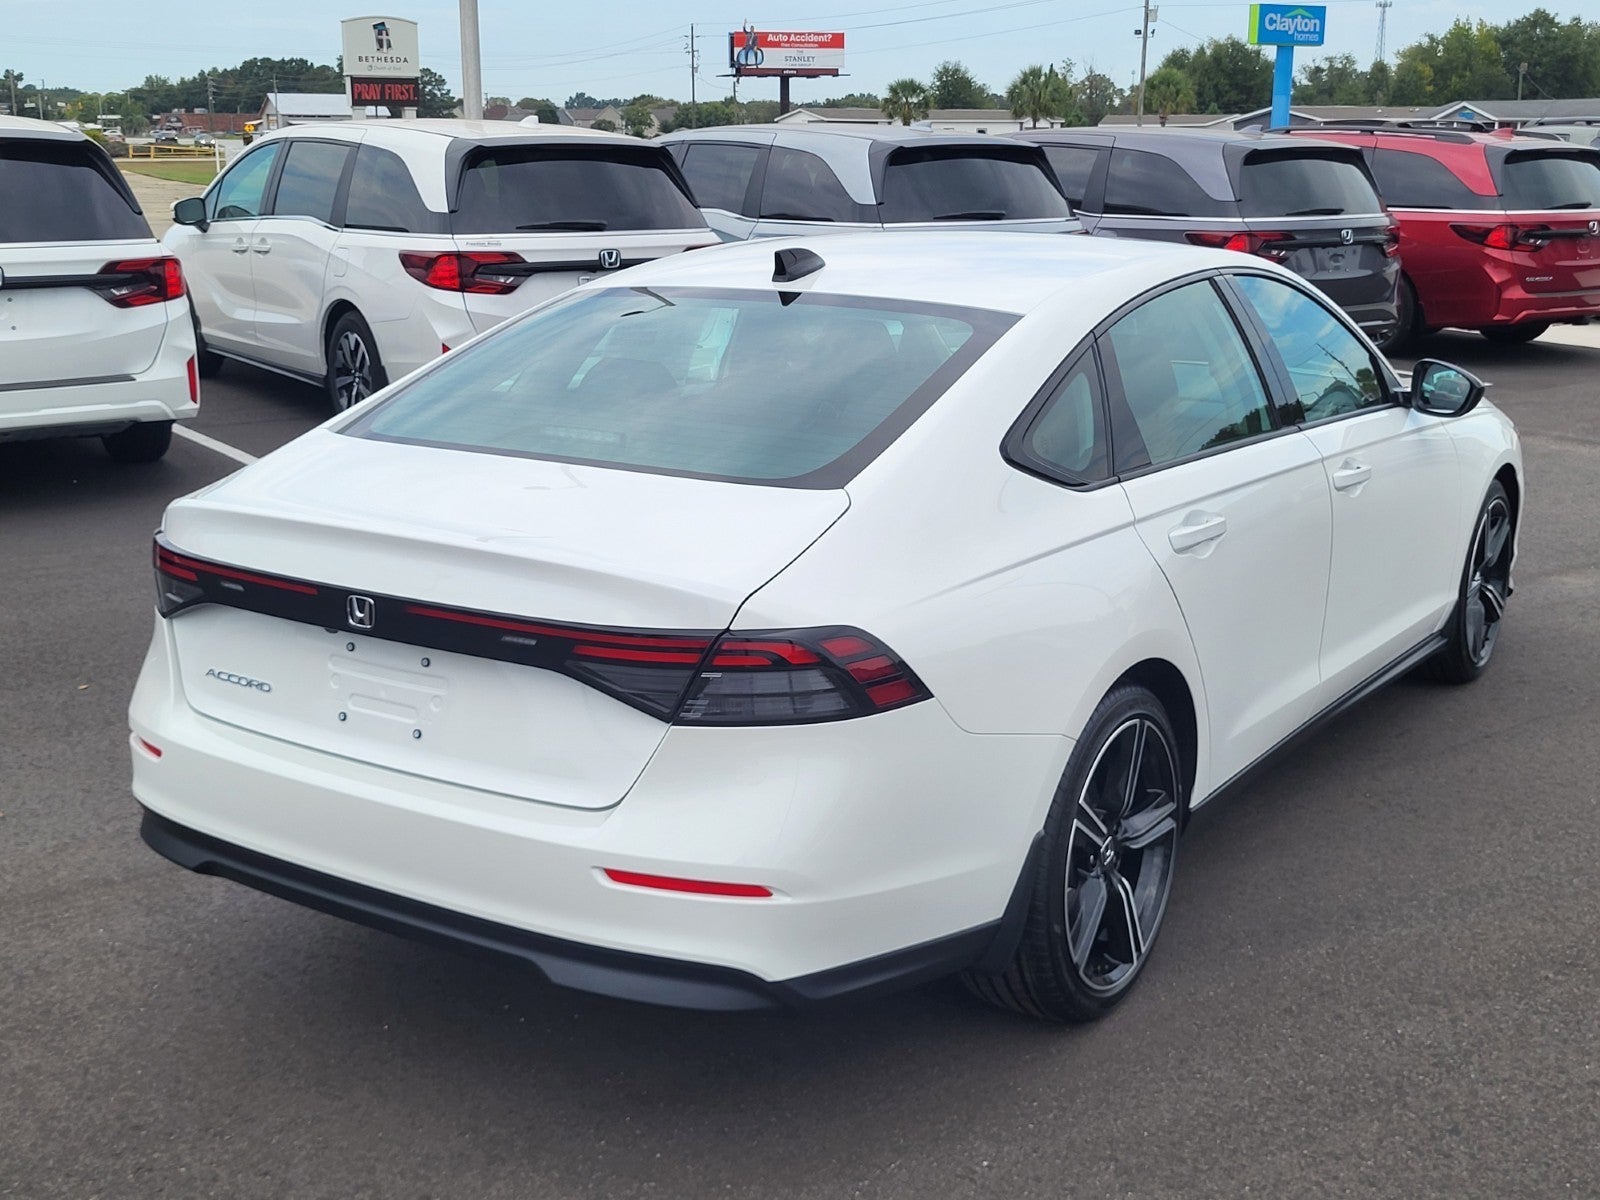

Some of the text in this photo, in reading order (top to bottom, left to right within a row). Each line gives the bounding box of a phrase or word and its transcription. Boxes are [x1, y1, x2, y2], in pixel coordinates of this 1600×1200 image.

[1264, 13, 1320, 34] Clayton
[767, 33, 833, 42] Auto Accident?
[1294, 31, 1319, 41] homes
[358, 55, 409, 64] BETHESDA
[353, 83, 418, 100] PRAY FIRST.
[205, 668, 272, 693] ACCORD
